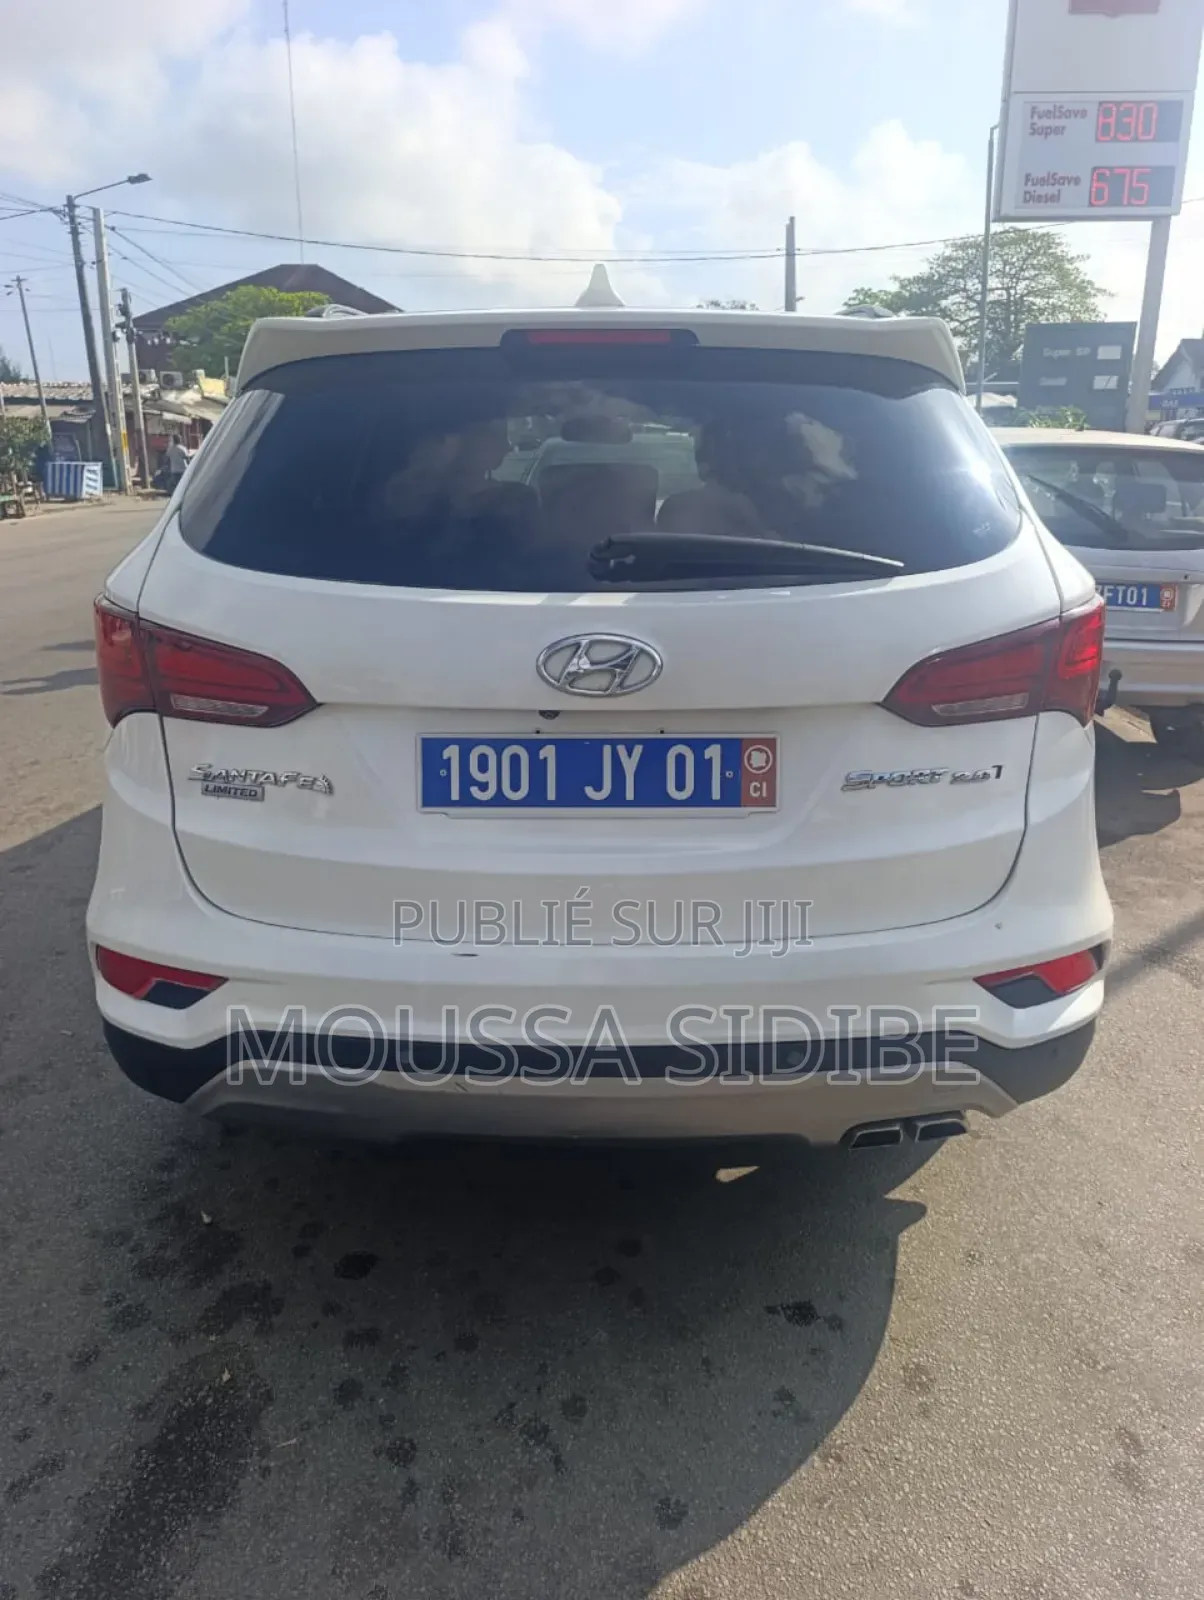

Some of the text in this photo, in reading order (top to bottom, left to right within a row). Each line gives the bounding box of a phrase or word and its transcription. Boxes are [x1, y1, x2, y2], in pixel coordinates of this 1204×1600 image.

[1030, 104, 1088, 120] FuelSave
[1029, 122, 1067, 139] Super
[1097, 103, 1159, 142] 830
[1024, 171, 1081, 187] FuelSave
[1091, 168, 1151, 206] 675
[1023, 189, 1061, 204] Diesel
[442, 744, 721, 801] 1901 JY 01
[204, 783, 258, 798] LIMITED
[749, 781, 767, 798] CI
